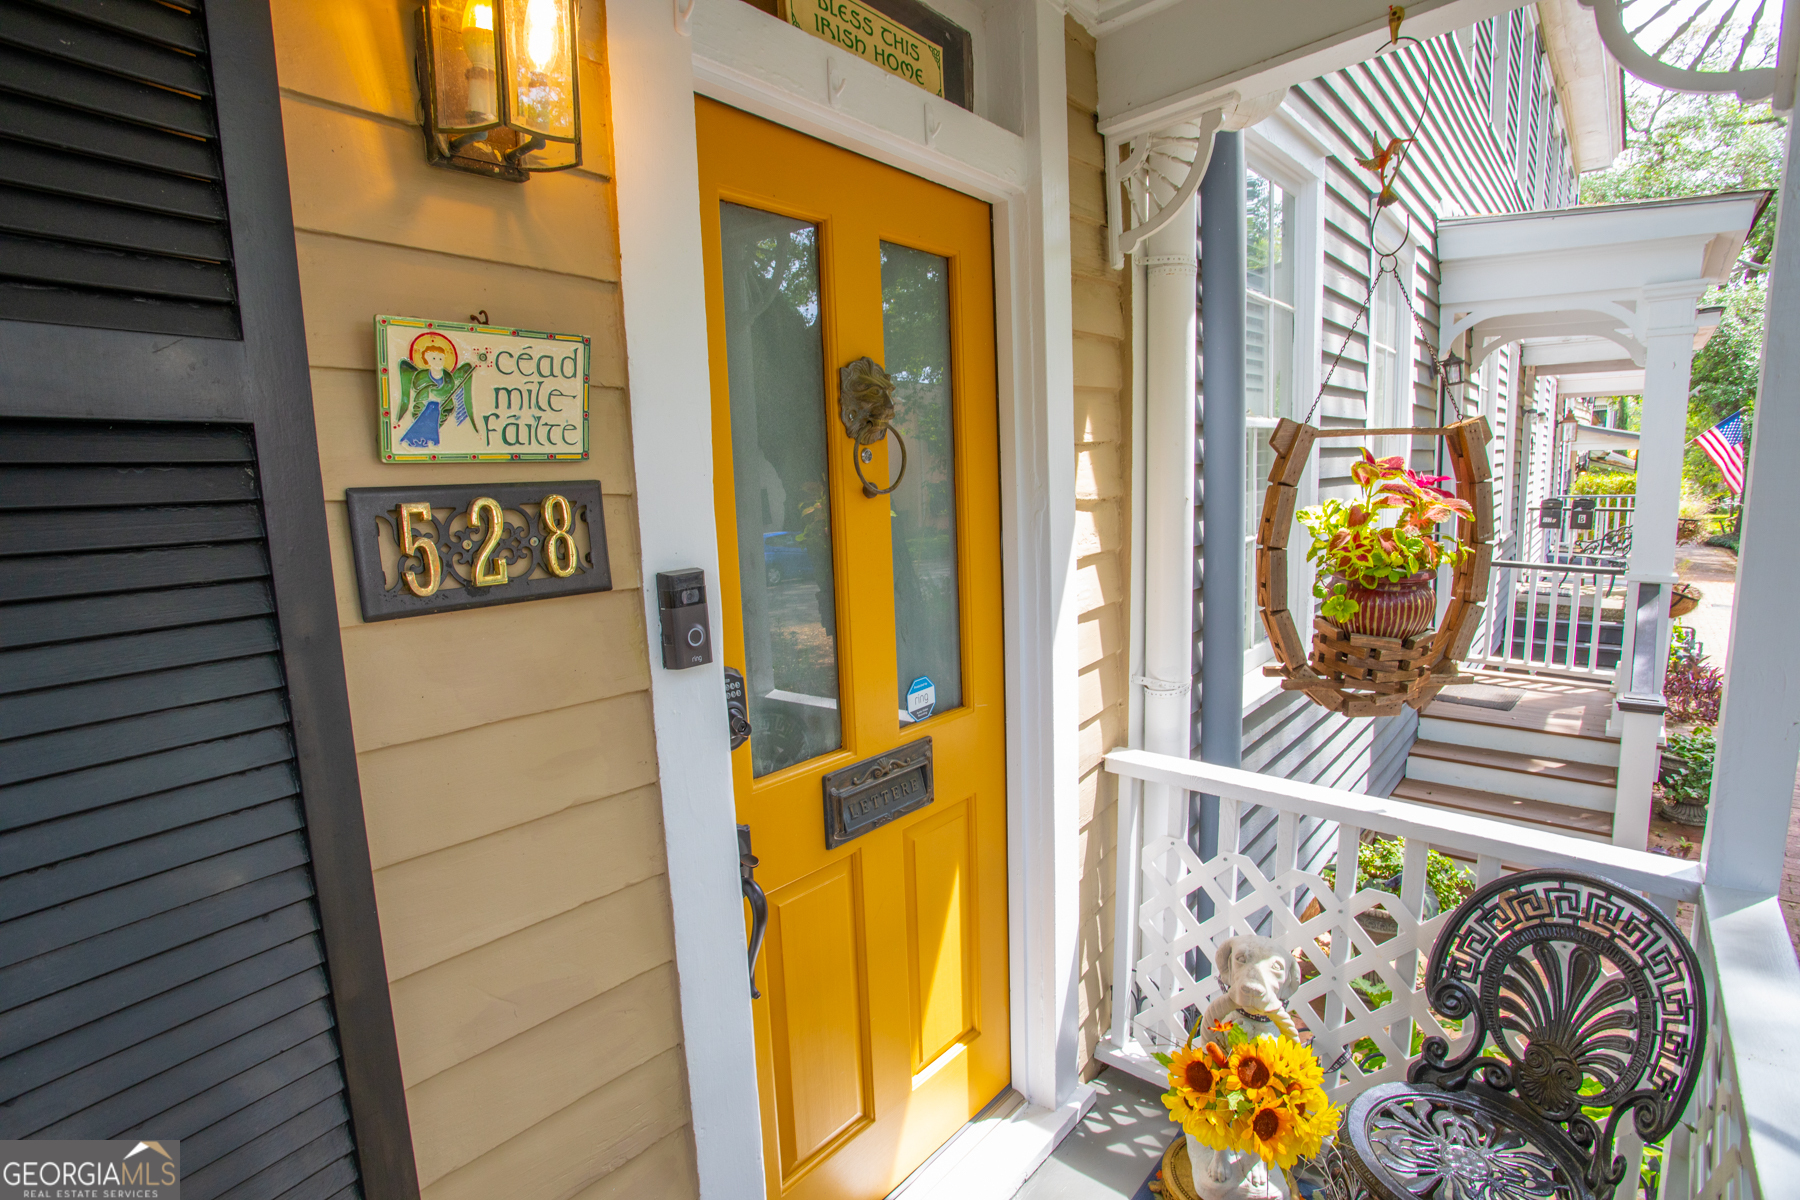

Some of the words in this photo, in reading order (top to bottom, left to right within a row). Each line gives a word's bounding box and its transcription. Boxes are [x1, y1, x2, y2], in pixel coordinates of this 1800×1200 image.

[880, 26, 920, 61] THIS
[874, 45, 924, 85] HOME
[397, 494, 577, 597] 528
[691, 655, 703, 663] ring
[914, 692, 929, 706] ring
[848, 777, 920, 820] LETTERE
